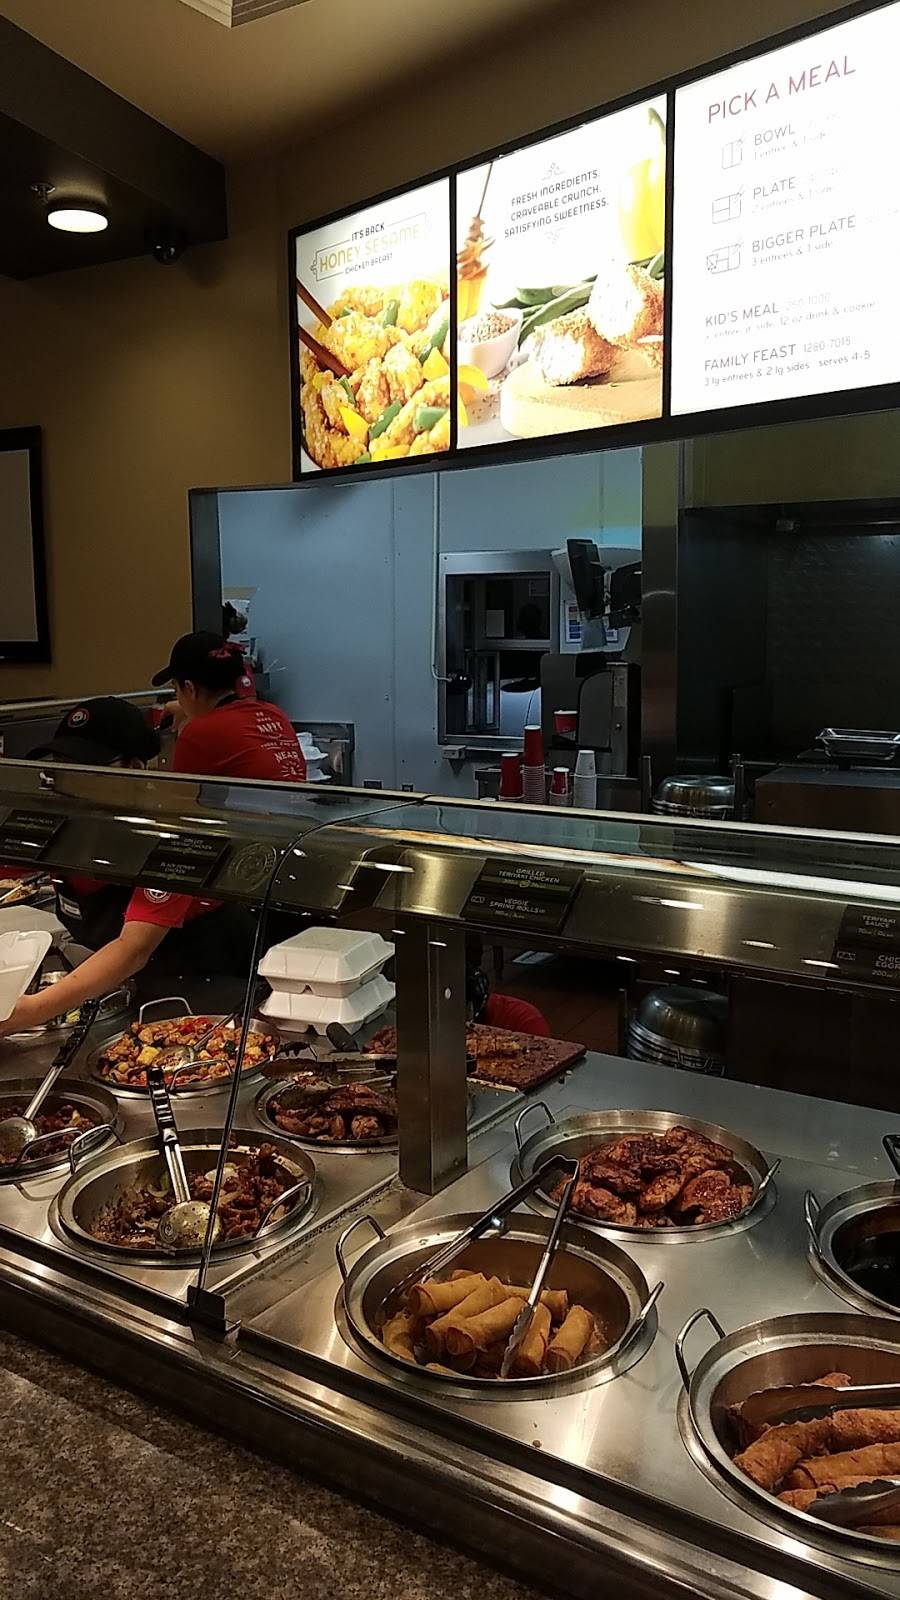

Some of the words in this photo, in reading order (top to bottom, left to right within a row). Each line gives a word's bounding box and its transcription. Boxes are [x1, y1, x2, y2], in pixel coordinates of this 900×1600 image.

[708, 89, 757, 124] PICK
[765, 82, 780, 104] A
[788, 55, 856, 95] MEAL
[754, 123, 796, 146] BOWL
[511, 190, 538, 207] FRESH
[540, 169, 600, 198] INGREDIENTS.
[753, 176, 796, 200] PLATE
[510, 198, 560, 222] CRAVEABLE
[561, 184, 602, 205] CRUNCH.
[366, 222, 385, 237] BACK
[504, 216, 552, 239] SATISFYING
[554, 197, 609, 222] SWEETNESS.
[752, 229, 804, 253] BIGGER
[809, 215, 855, 238] PLATE
[319, 245, 361, 273] HONEY
[365, 224, 421, 256] SESAME
[705, 311, 738, 328] KID'S
[742, 302, 780, 320] MEAL
[704, 353, 749, 372] FAMILY
[753, 344, 797, 363] FEAST
[721, 371, 754, 384] entrees
[756, 368, 763, 378] &
[766, 366, 773, 376] 2
[775, 365, 784, 377] lg
[818, 356, 849, 368] serves
[273, 751, 300, 764] NEAR
[529, 875, 560, 883] CHICKEN
[489, 901, 516, 910] SPRING
[516, 905, 539, 913] ROLLS
[504, 898, 529, 906] VEGGIE
